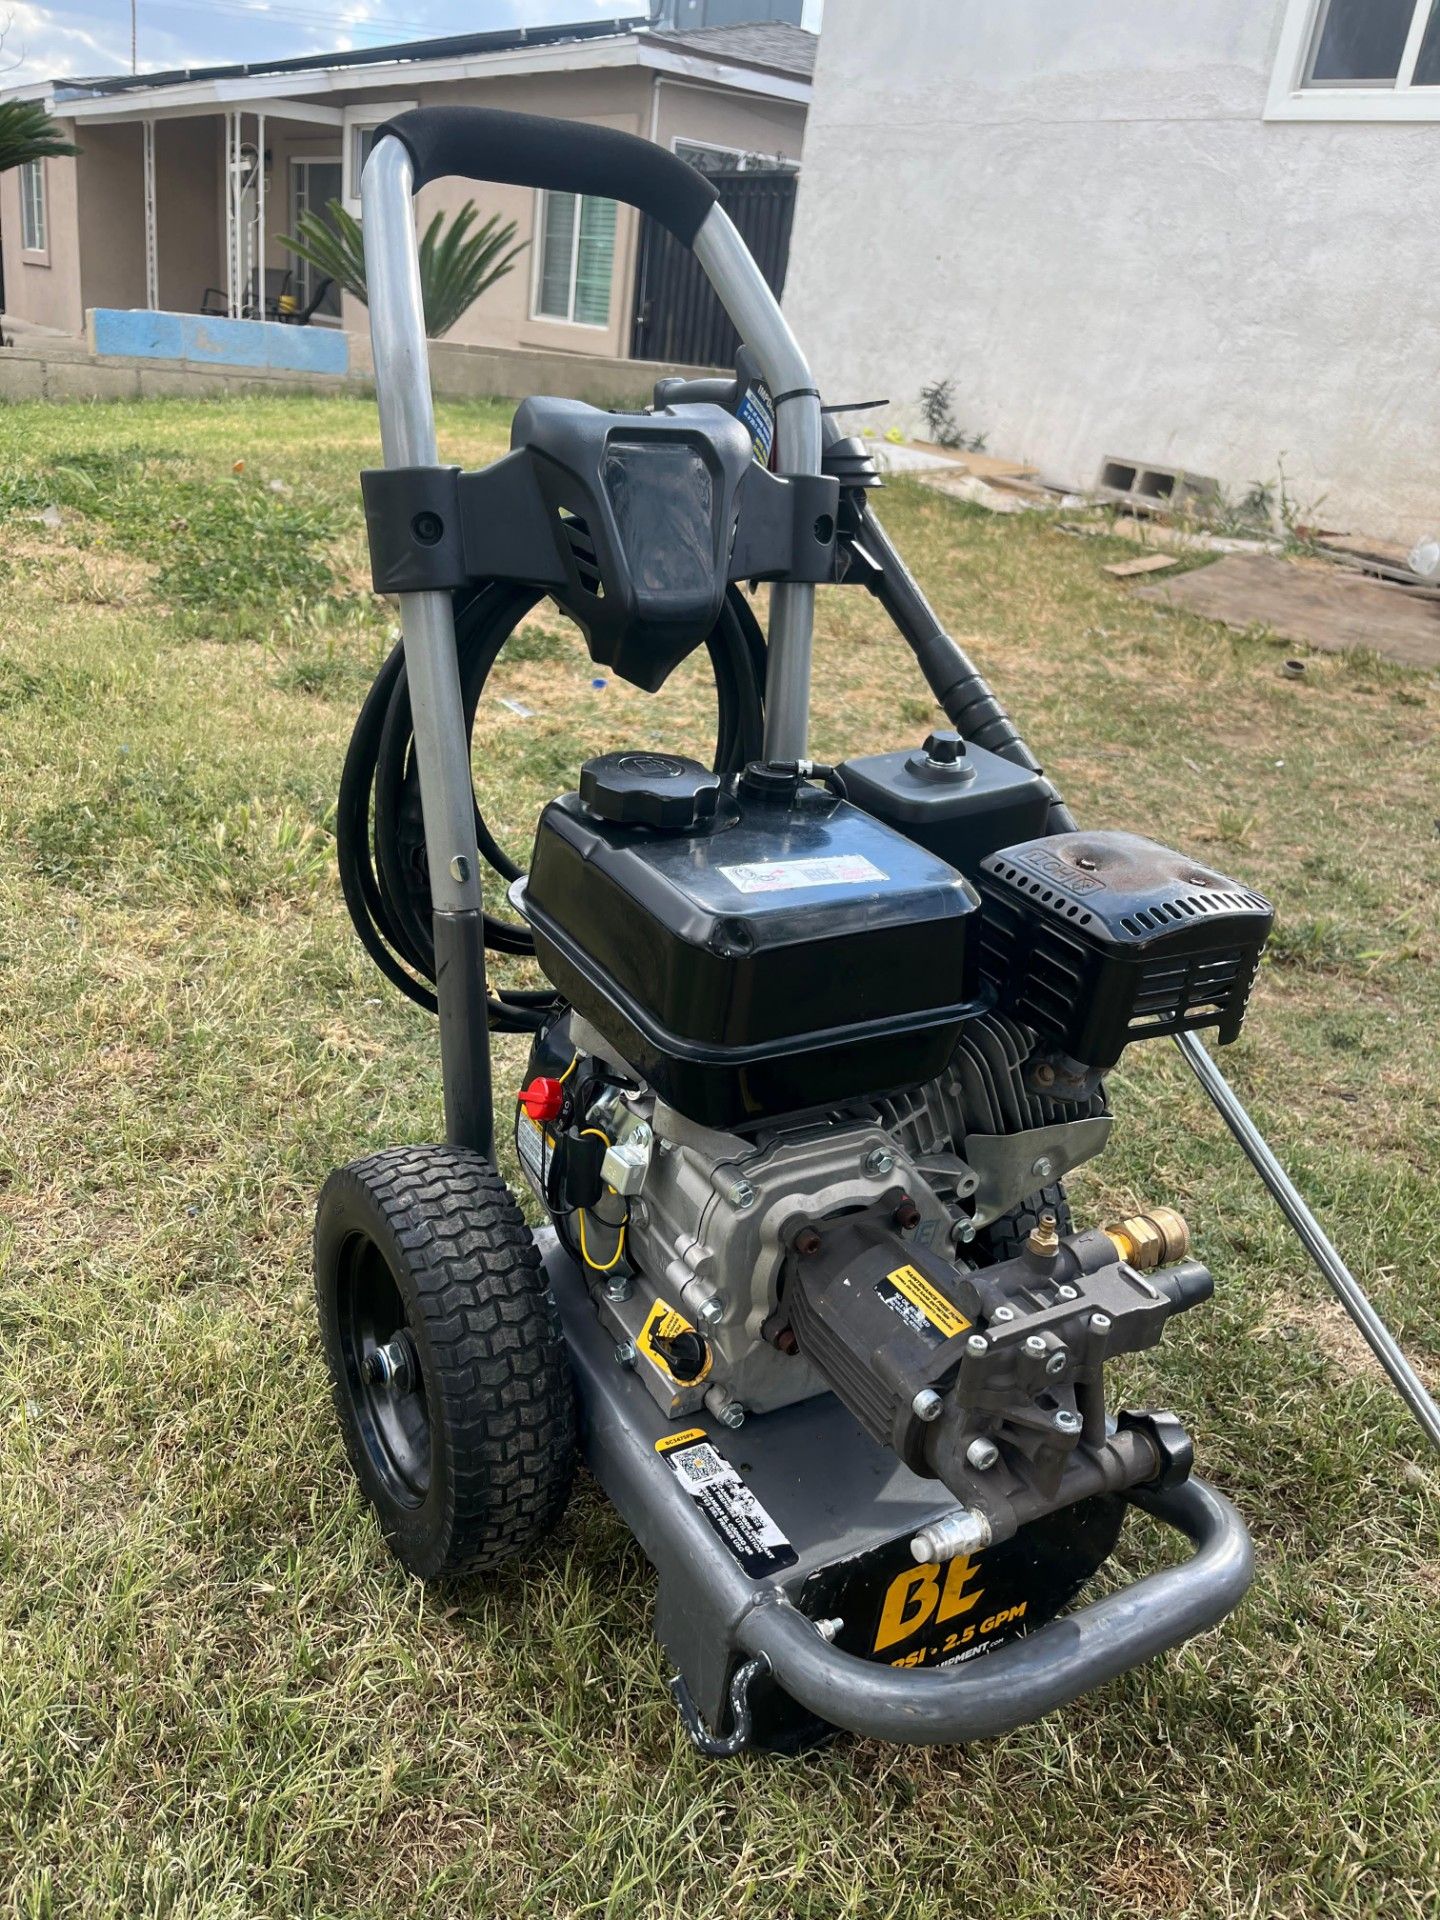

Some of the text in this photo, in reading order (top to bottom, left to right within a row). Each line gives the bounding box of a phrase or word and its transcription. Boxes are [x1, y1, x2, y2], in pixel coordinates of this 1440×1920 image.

[905, 1270, 937, 1300] MAINTENANCE
[936, 1300, 949, 1313] FREE
[874, 1548, 985, 1653] BE
[942, 1624, 977, 1652] 2.5
[979, 1601, 1028, 1634] GPM
